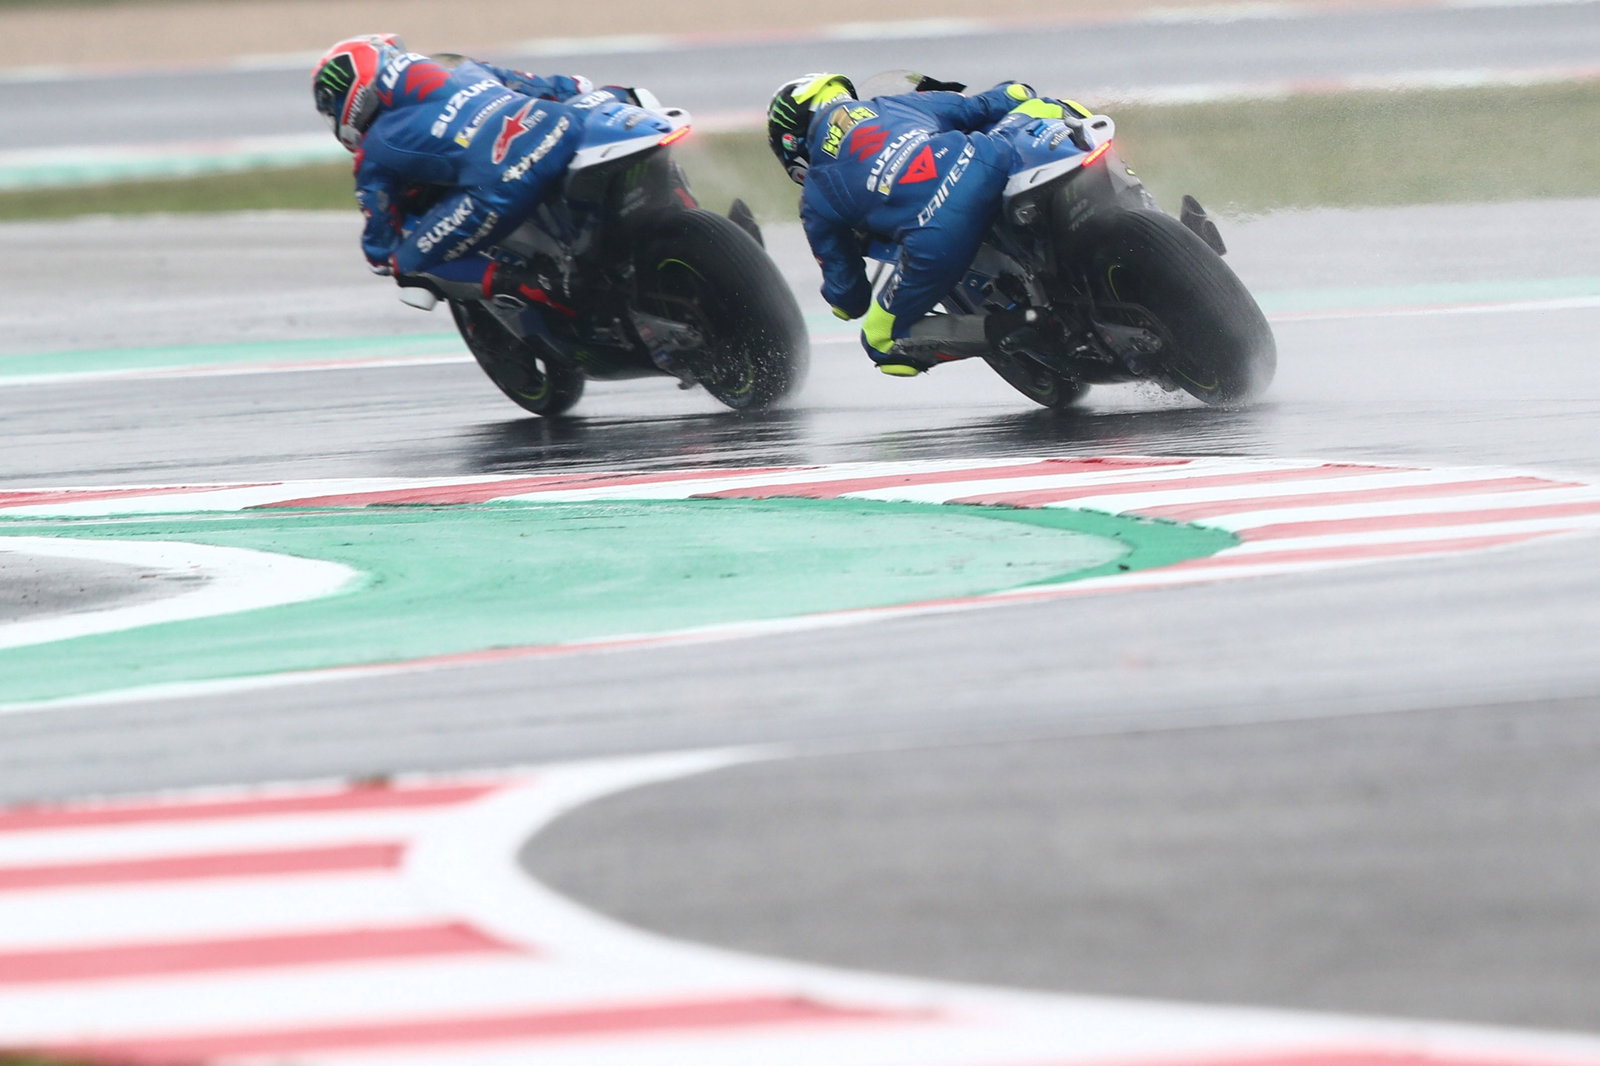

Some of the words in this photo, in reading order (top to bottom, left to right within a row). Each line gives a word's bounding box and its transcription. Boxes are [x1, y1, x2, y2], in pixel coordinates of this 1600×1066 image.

[431, 79, 503, 138] SUZUKI
[501, 115, 570, 182] alpinestars
[866, 129, 929, 192] SUZUKI
[890, 136, 926, 173] MICHELIN
[917, 142, 976, 227] DAINESE
[417, 196, 474, 253] SUZUKI
